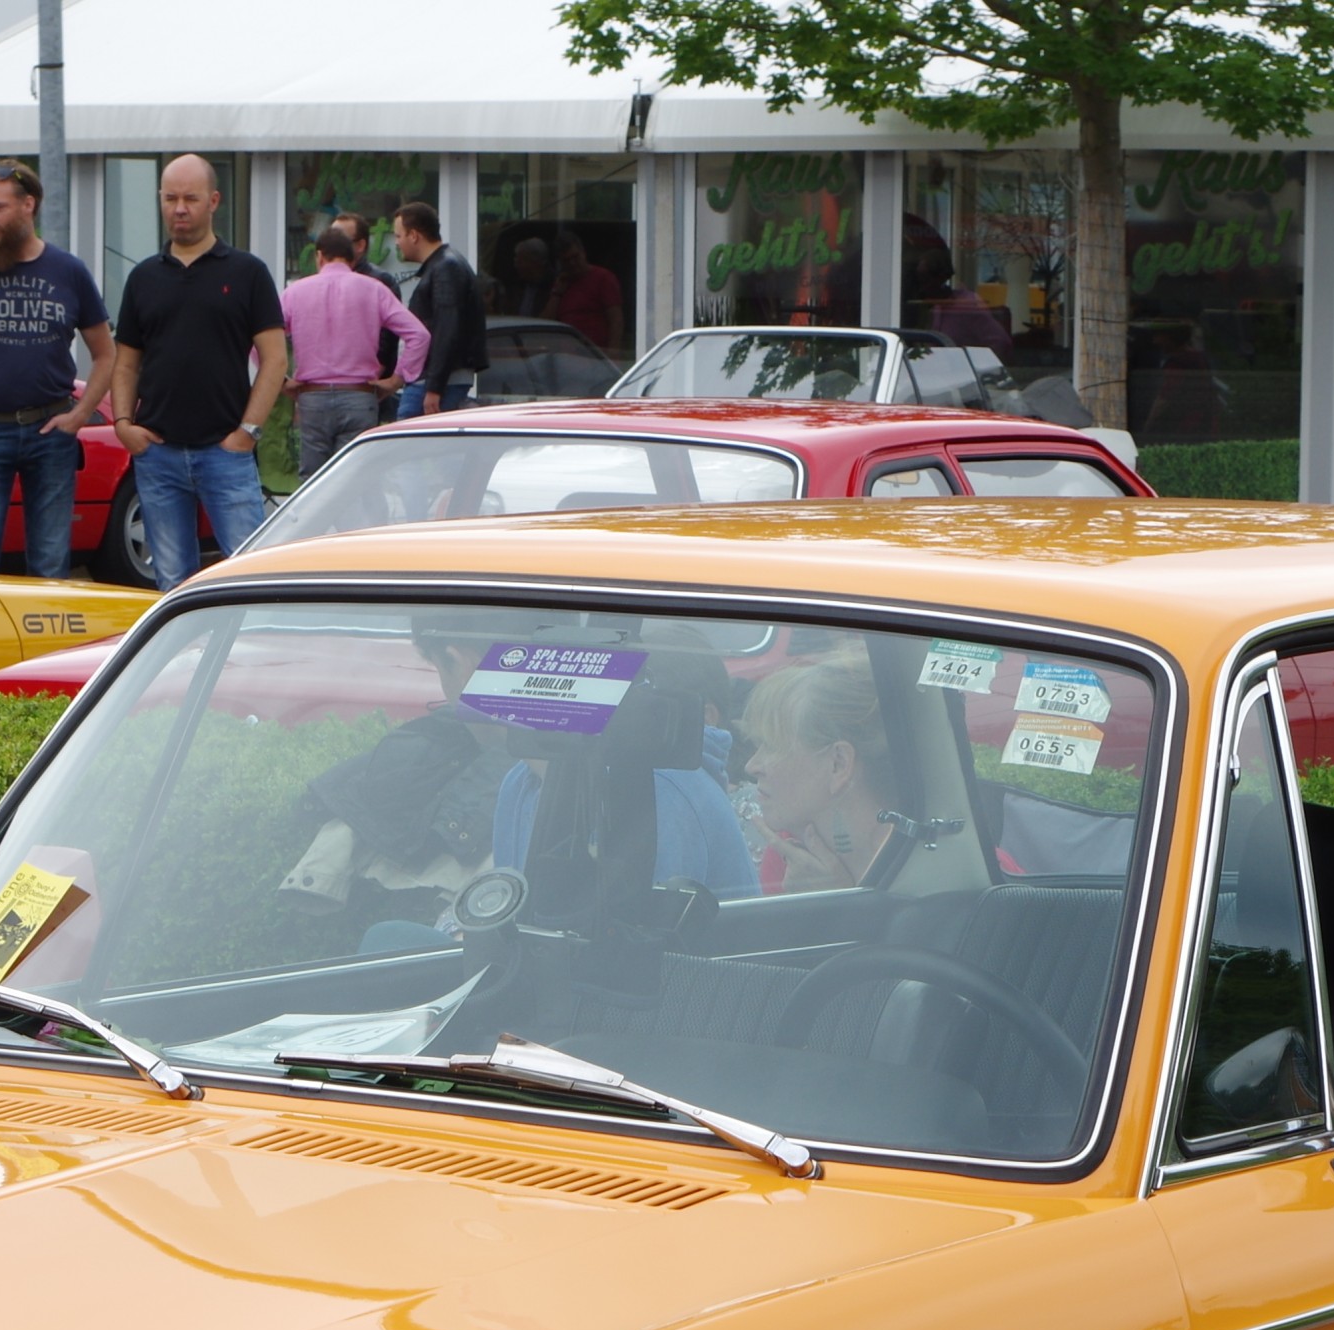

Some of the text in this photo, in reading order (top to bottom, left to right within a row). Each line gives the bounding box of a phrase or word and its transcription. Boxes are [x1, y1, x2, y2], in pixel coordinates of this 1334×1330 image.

[706, 208, 852, 292] geht's!
[1132, 207, 1294, 294] geht's!
[22, 613, 87, 634] GT/E
[532, 649, 612, 665] SPA-CLASSIC
[525, 661, 605, 675] 24-26 mai 2013
[929, 659, 983, 677] 1404
[523, 676, 576, 691] RAIDILLON
[1035, 686, 1090, 705] 0793
[1019, 738, 1075, 756] 0655
